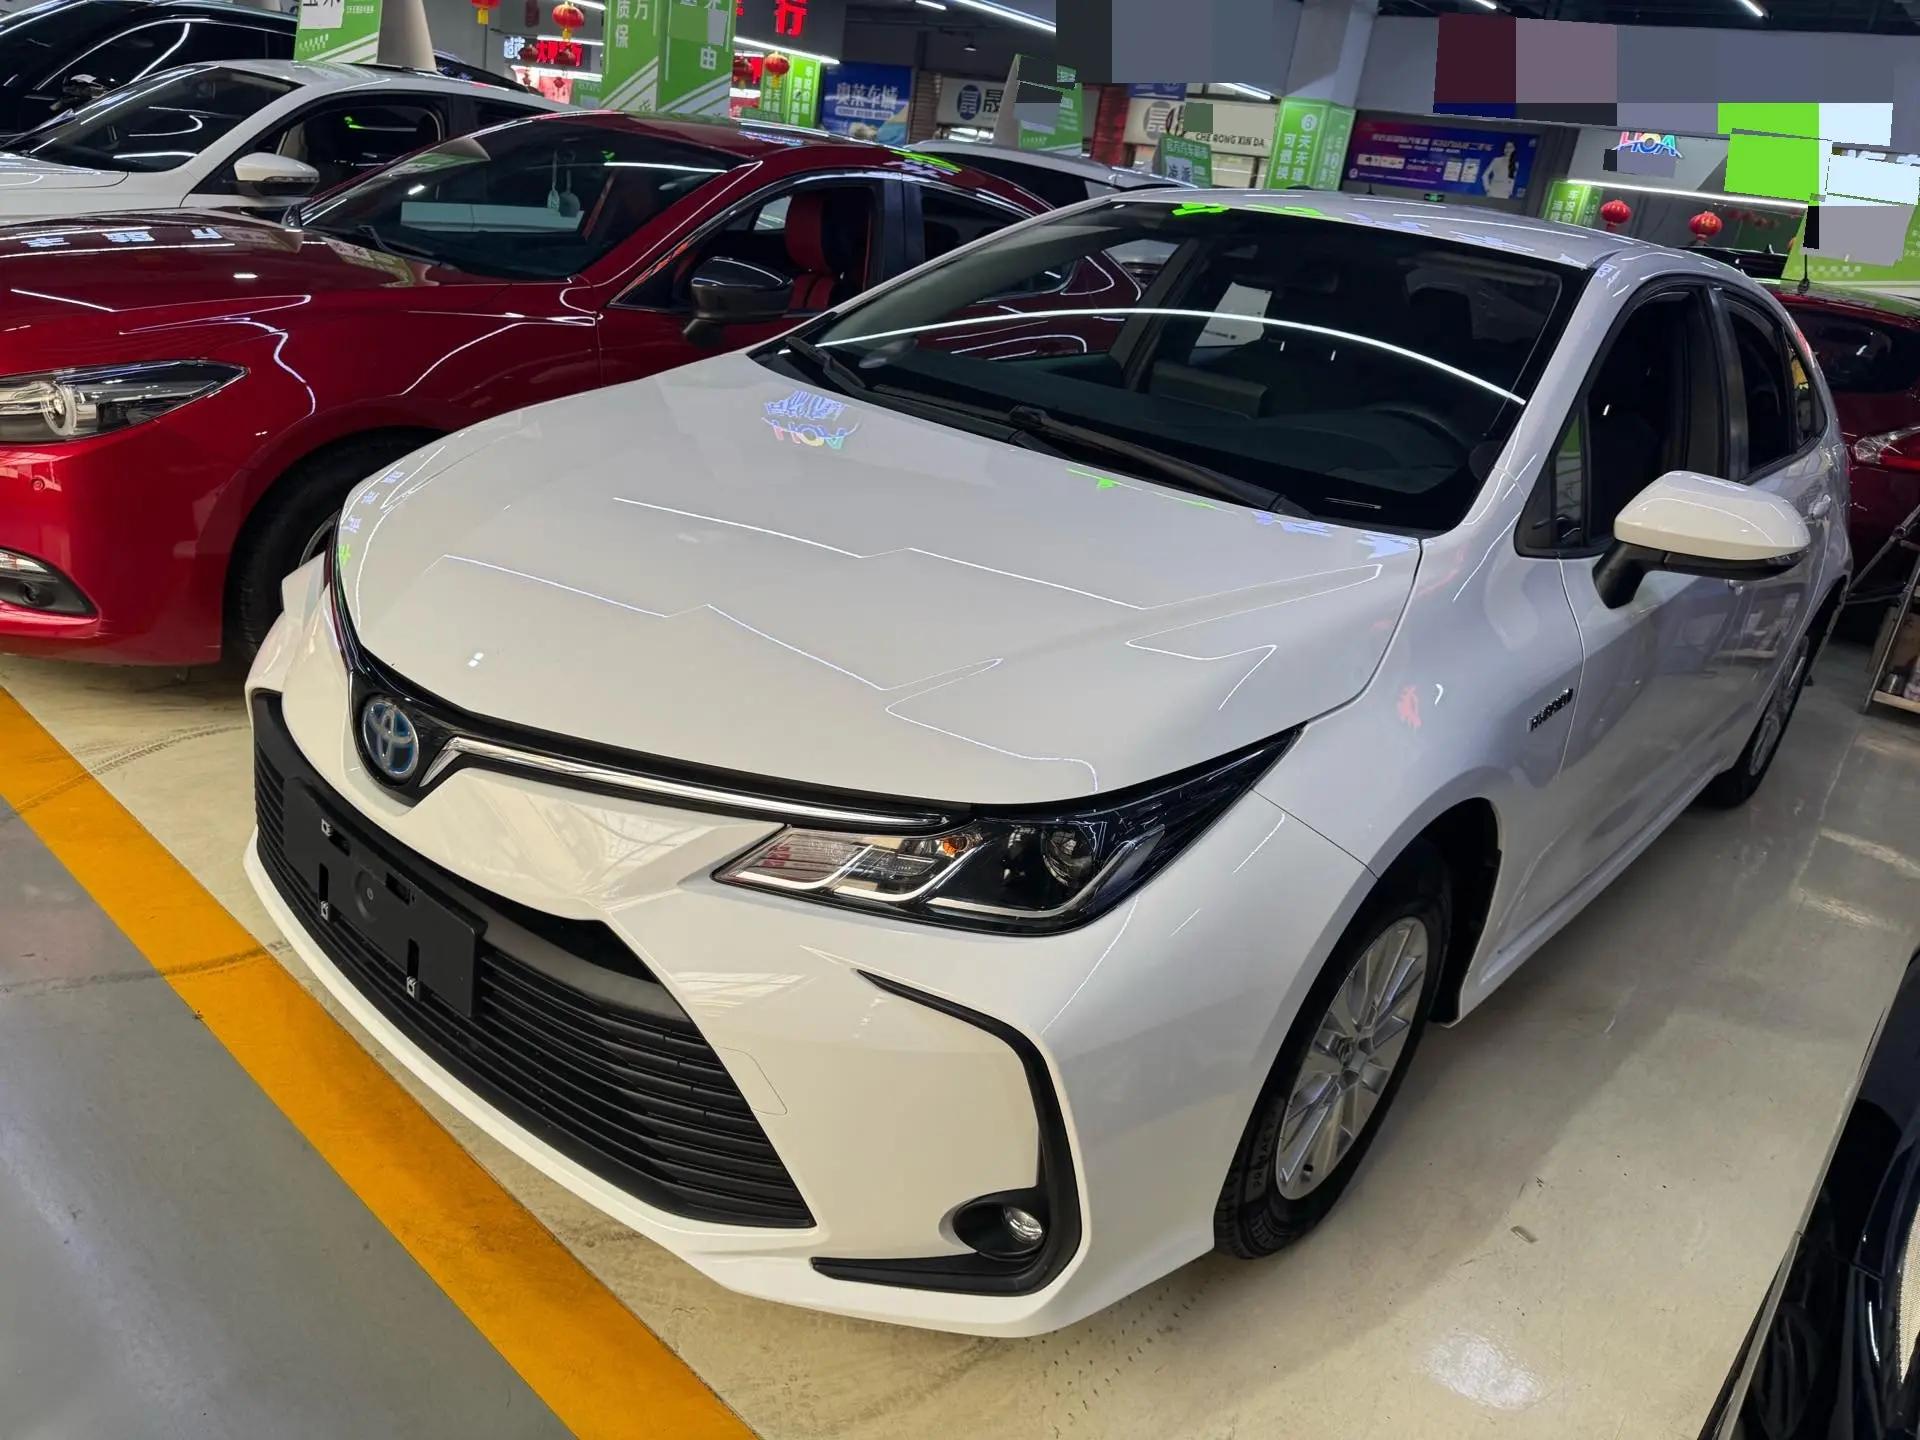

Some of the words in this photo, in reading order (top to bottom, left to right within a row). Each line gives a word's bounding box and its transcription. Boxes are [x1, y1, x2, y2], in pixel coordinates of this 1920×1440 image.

[615, 0, 630, 48] 质保
[1195, 132, 1211, 142] CHE
[1213, 133, 1237, 145] RONG
[1238, 136, 1251, 146] XIN
[1253, 137, 1265, 147] DA
